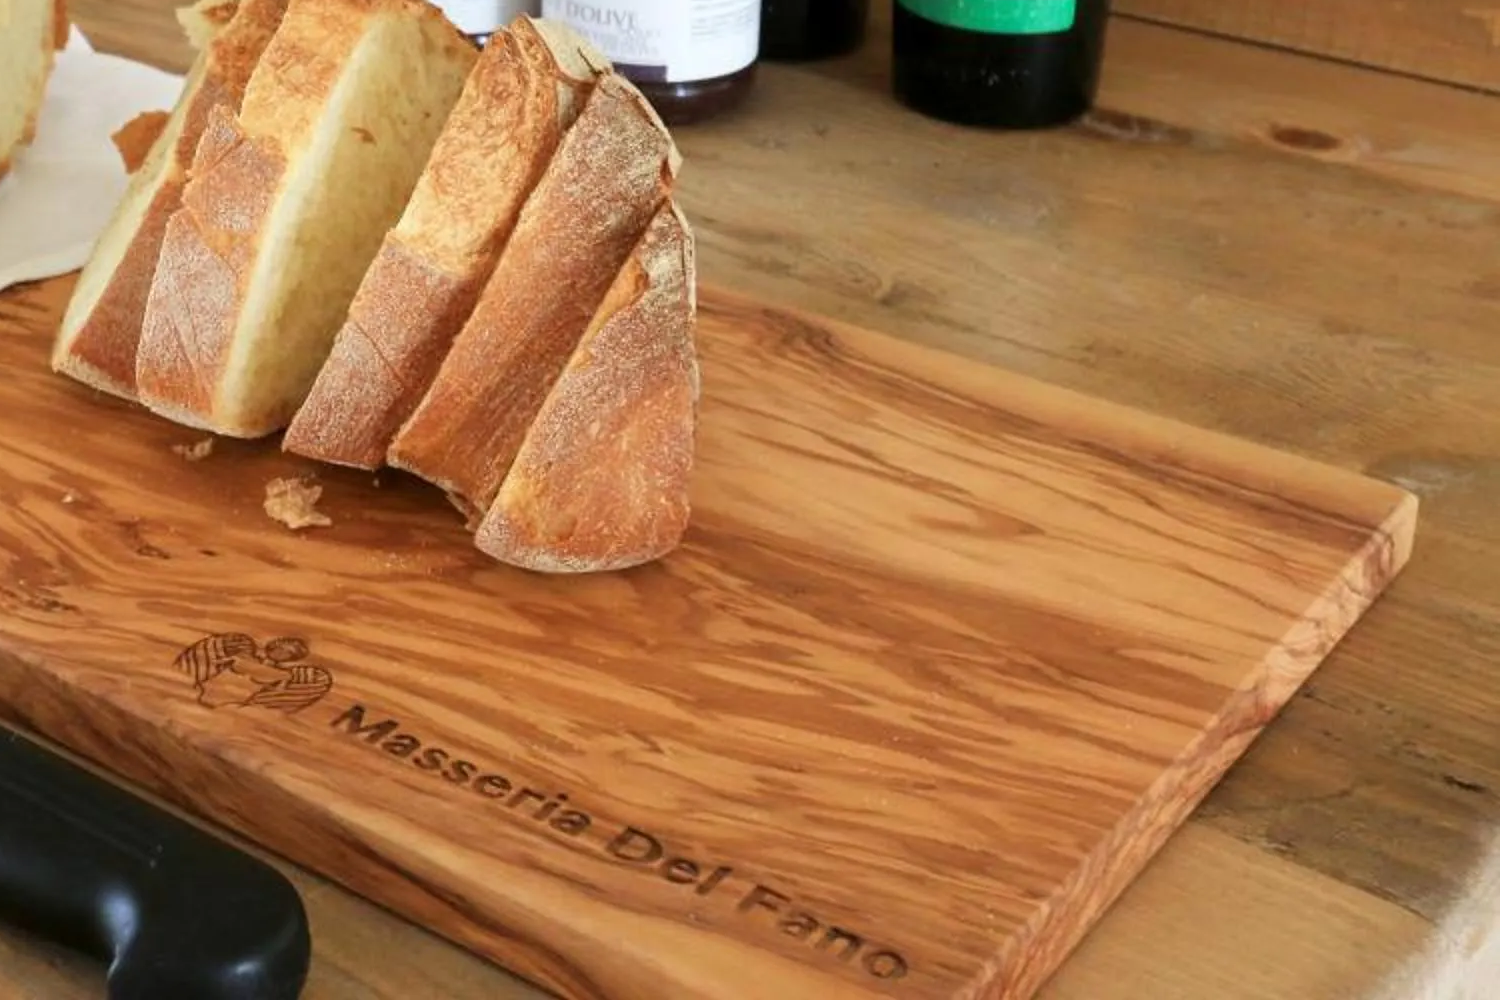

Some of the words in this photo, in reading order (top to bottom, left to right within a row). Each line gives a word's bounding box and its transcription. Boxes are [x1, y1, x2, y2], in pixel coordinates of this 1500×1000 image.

[331, 703, 595, 838] Masseria
[603, 824, 733, 897] Del
[736, 884, 911, 981] Fano
